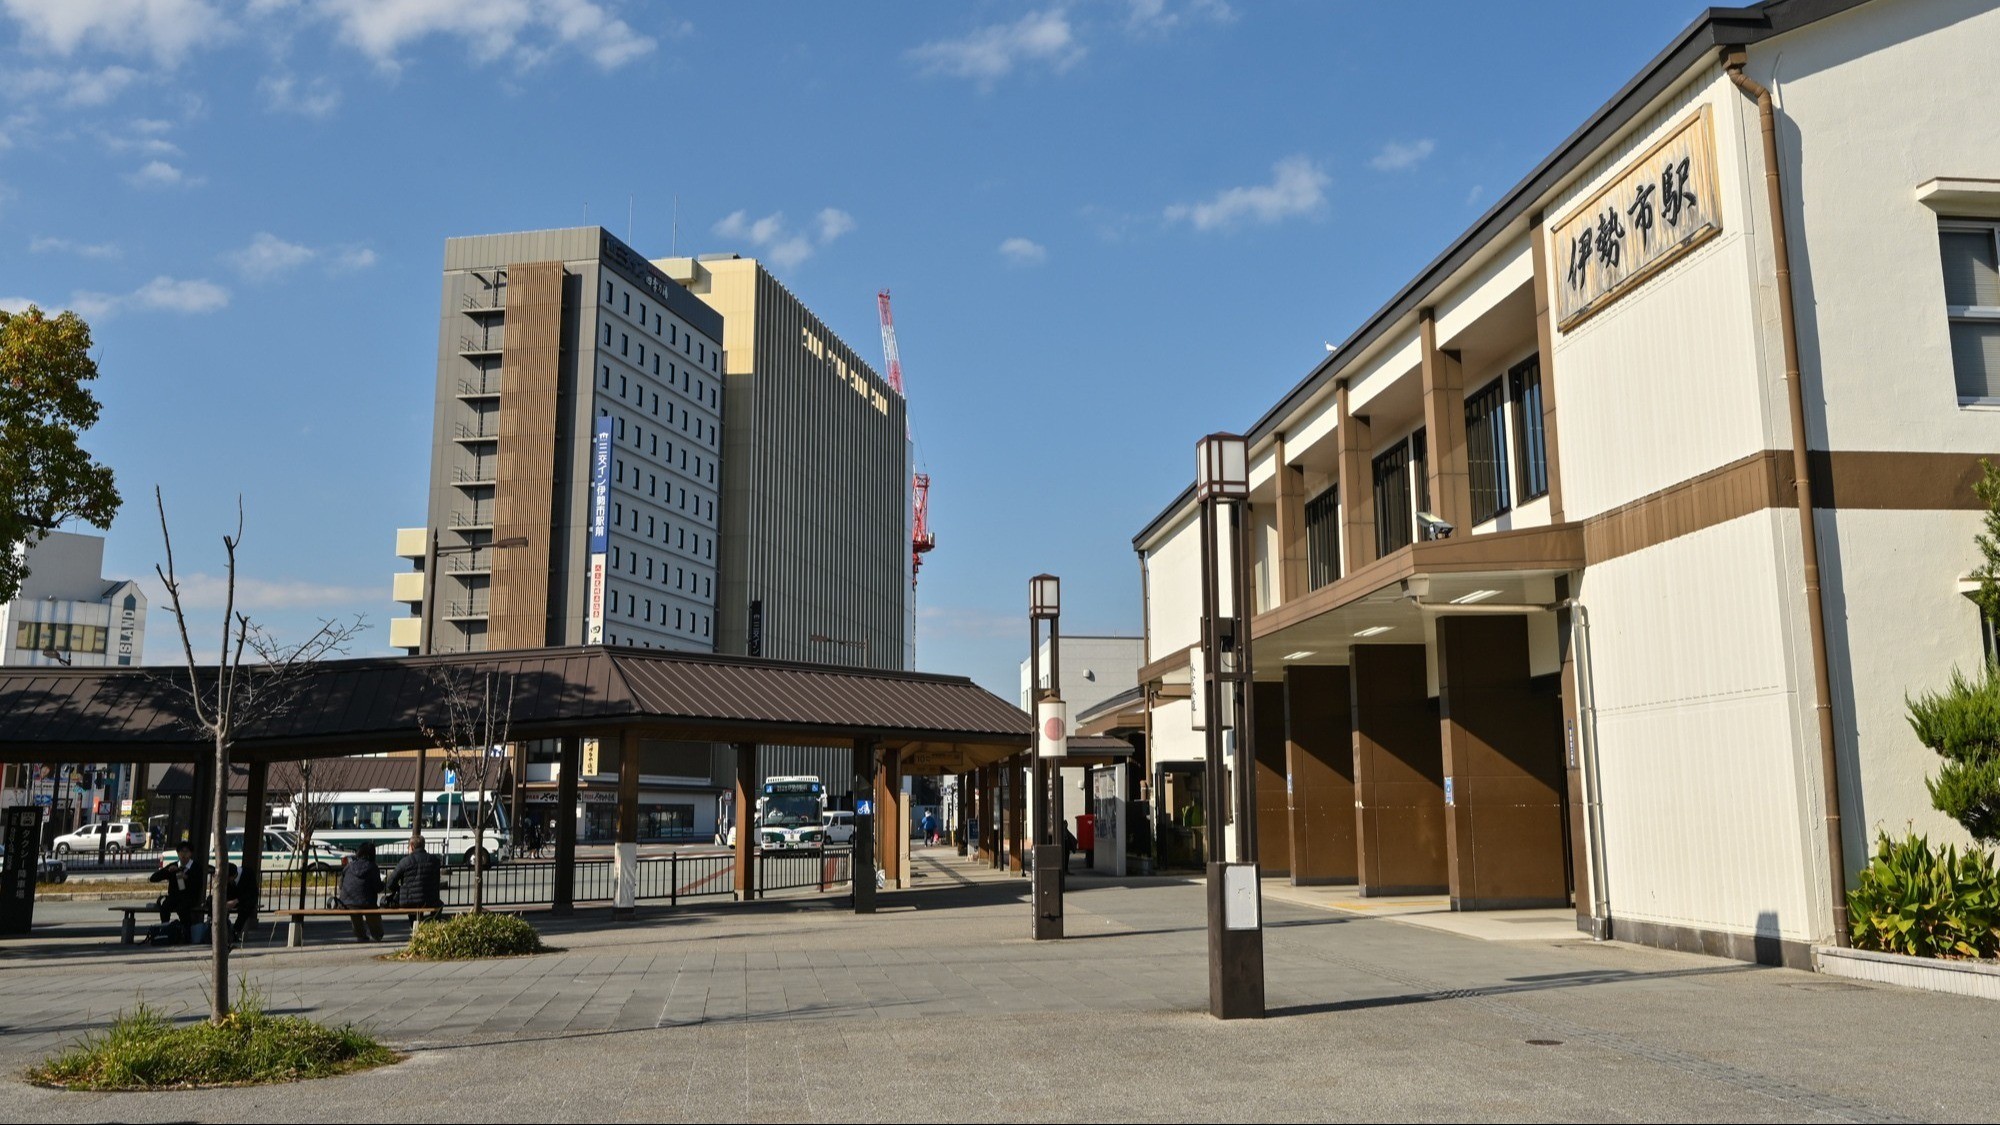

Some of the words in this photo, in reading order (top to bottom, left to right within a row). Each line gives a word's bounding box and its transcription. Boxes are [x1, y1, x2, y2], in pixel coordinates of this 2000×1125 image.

[1567, 156, 1697, 291] 伊勢市駅
[595, 442, 608, 537] 三交イン伊勢市駅前
[118, 609, 135, 657] ISLAND
